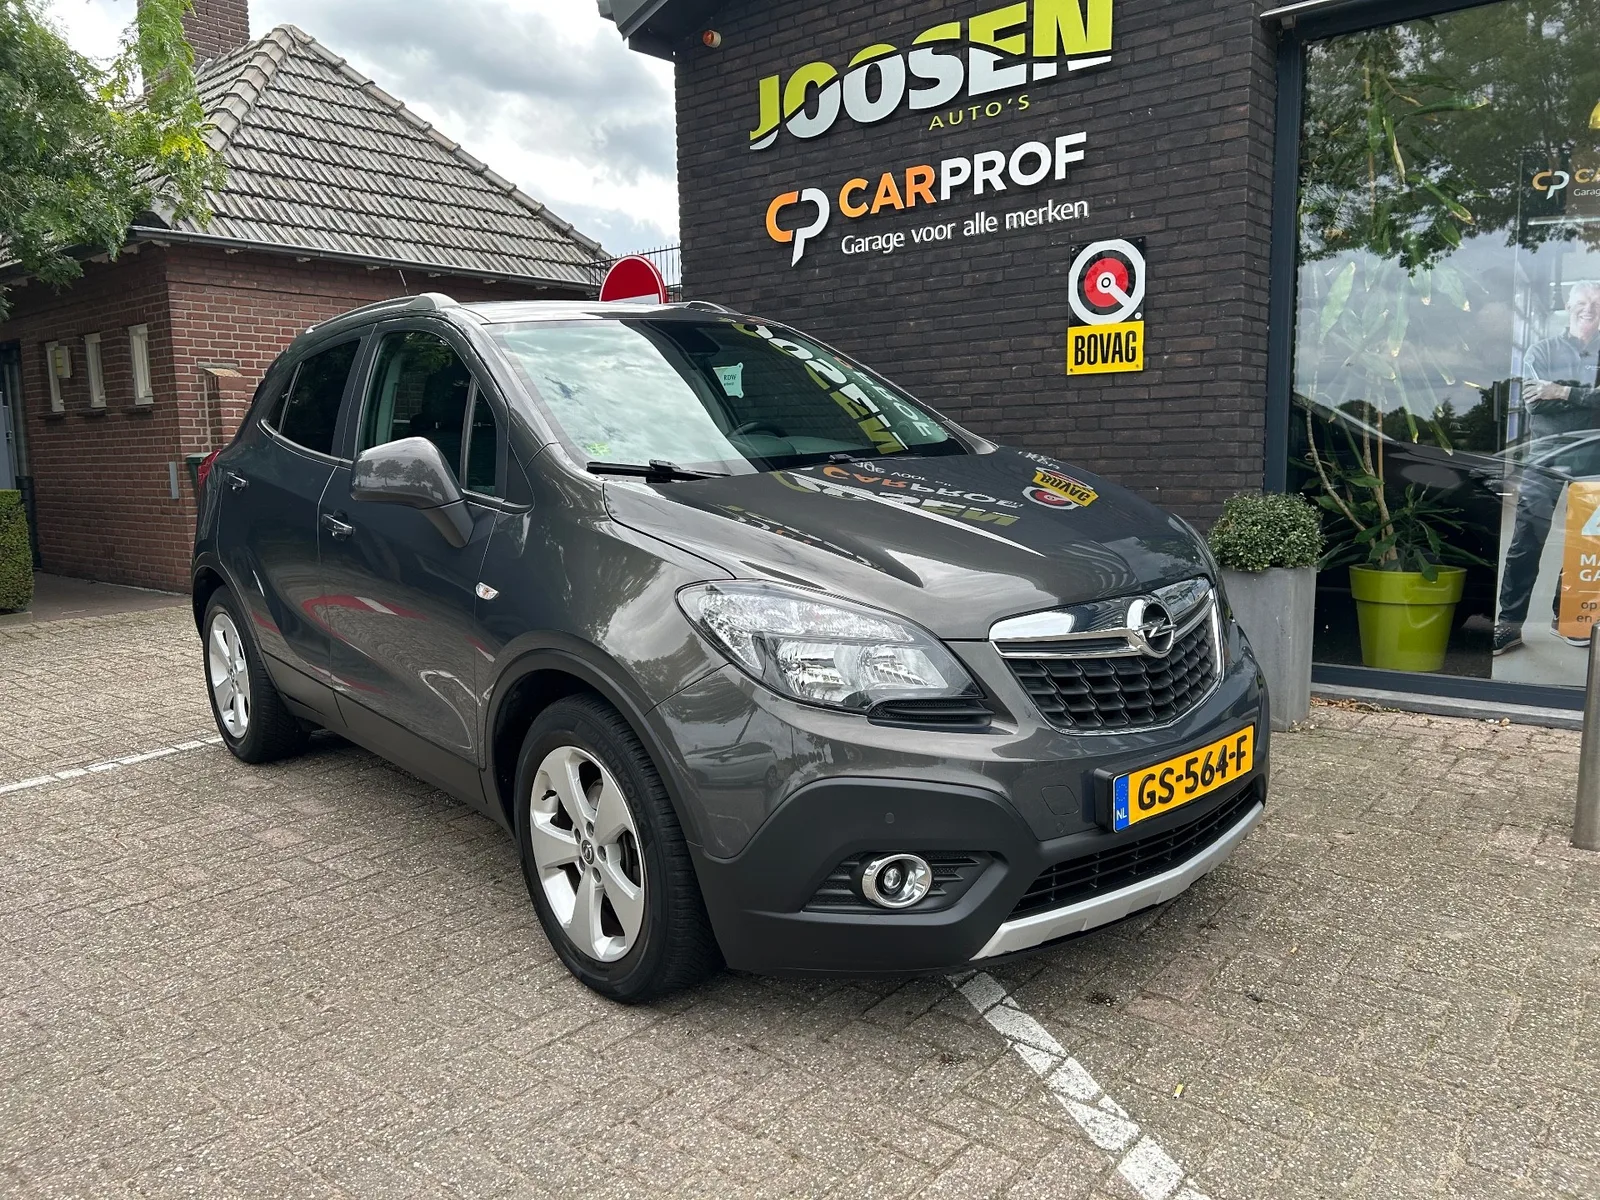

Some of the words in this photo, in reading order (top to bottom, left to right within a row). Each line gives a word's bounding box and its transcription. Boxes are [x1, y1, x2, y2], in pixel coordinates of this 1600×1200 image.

[750, 0, 1112, 150] JOOSEN
[929, 94, 1030, 131] AUTO'S
[838, 131, 1087, 218] CARPROF
[841, 230, 905, 255] Garage
[911, 221, 956, 244] voor
[963, 211, 998, 237] alle
[1005, 199, 1089, 230] merken
[1074, 330, 1137, 366] BOVAG
[1576, 615, 1592, 623] en
[1581, 601, 1598, 612] op
[1138, 734, 1248, 811] GS-564-F
[1116, 807, 1127, 821] NL
